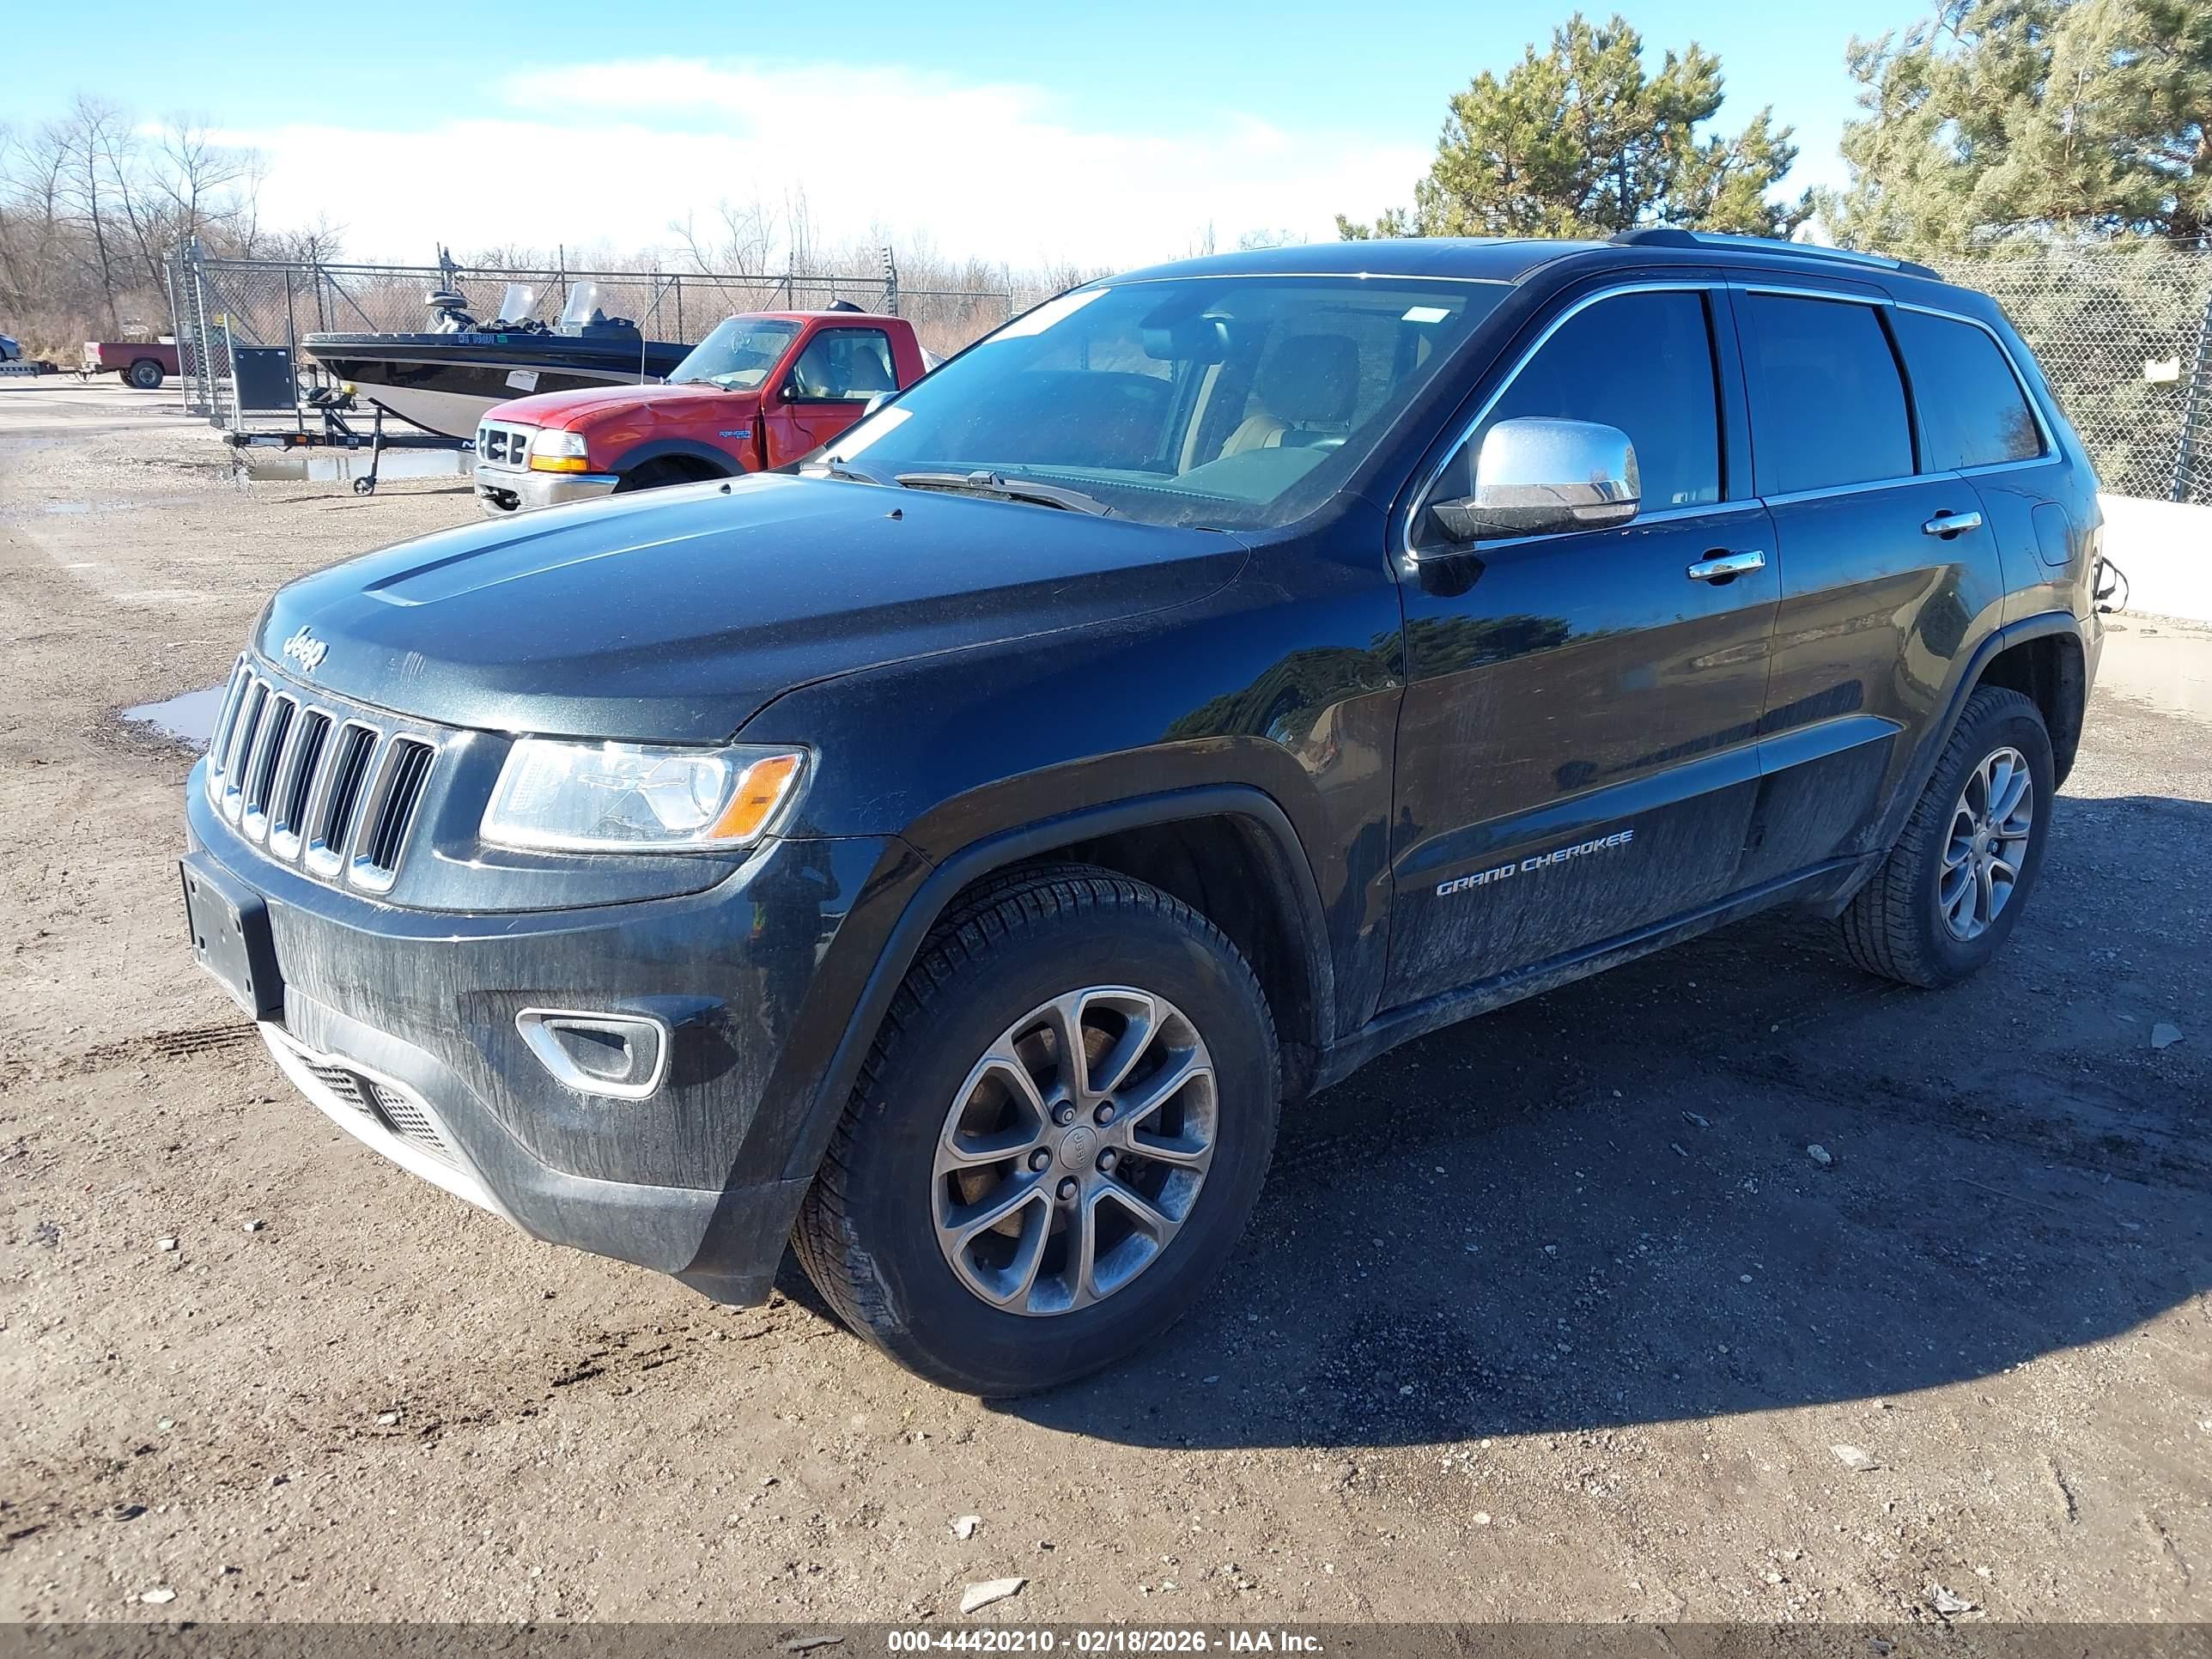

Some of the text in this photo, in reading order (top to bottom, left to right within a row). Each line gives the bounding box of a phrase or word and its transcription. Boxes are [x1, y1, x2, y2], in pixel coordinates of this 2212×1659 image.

[283, 624, 330, 673] Jeep
[1436, 830, 1634, 897] GRAND CHEROKEE
